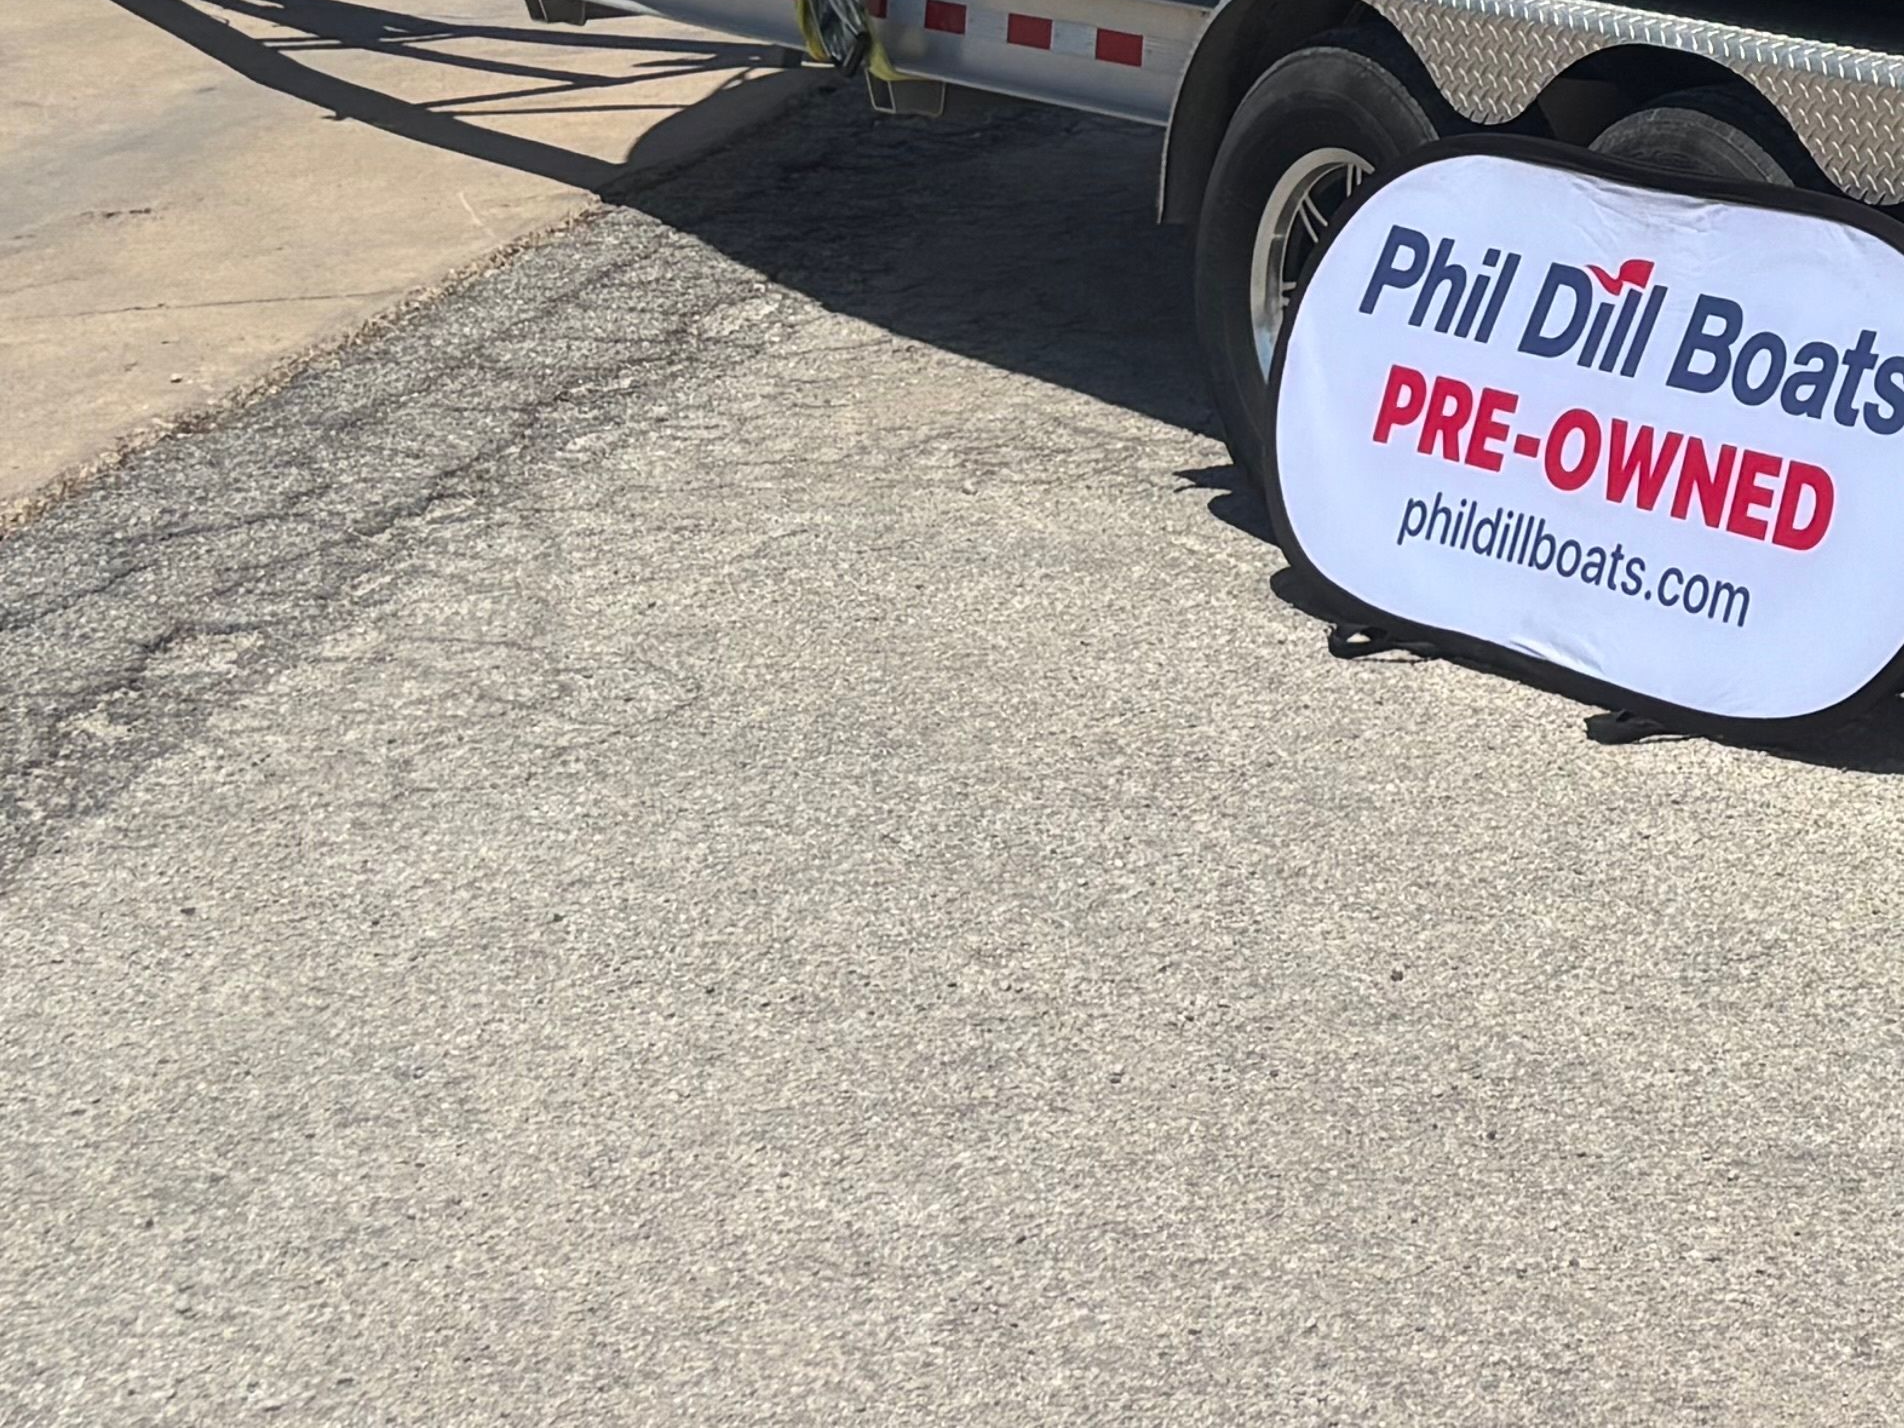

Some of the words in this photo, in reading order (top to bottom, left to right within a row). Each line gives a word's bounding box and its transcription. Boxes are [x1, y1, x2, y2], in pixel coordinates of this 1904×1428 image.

[1359, 225, 1521, 344] Phil
[1518, 258, 1664, 379] Dill
[1372, 364, 1836, 552] PRE-OWNED
[1399, 492, 1751, 629] phildillboats.com
